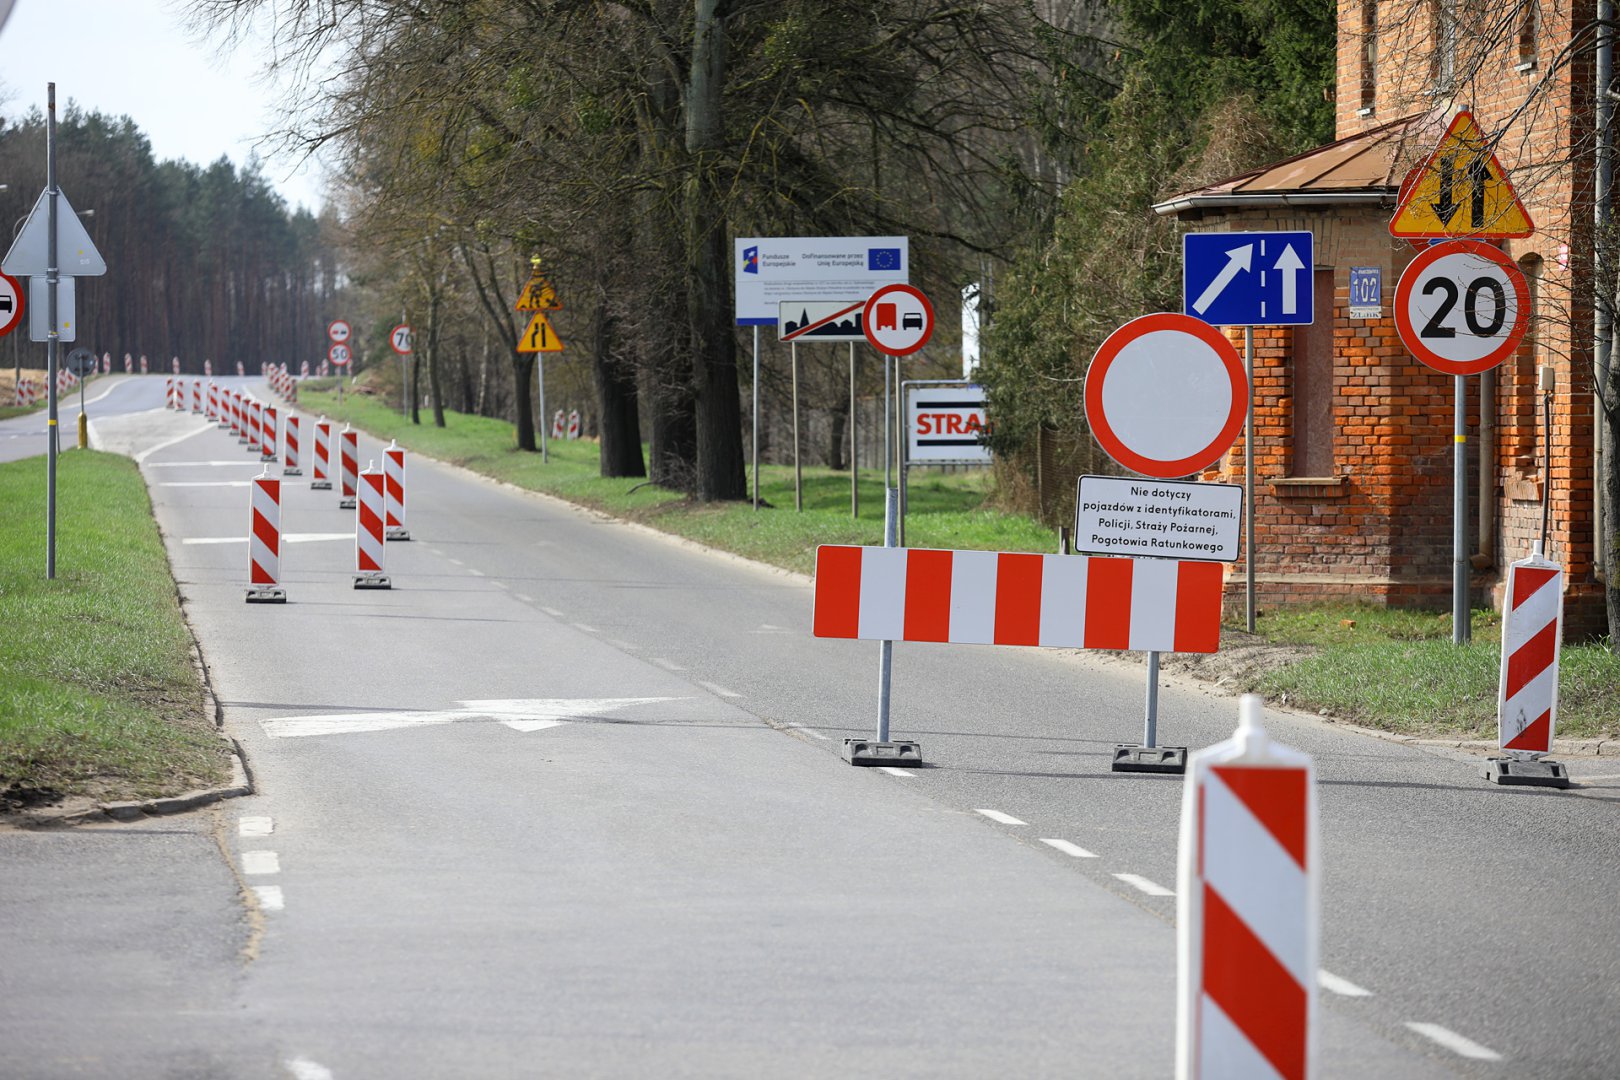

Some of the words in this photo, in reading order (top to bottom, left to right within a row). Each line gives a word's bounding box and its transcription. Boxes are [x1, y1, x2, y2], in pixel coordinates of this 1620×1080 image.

[1353, 278, 1377, 303] 102
[1420, 276, 1506, 339] 20
[332, 348, 348, 359] 50
[1130, 486, 1149, 497] Nie
[1151, 488, 1191, 501] dotyczy
[1083, 501, 1134, 513] pojazdów
[1144, 504, 1237, 520] identyfikatorami,
[1098, 517, 1133, 530] Policji,
[1136, 520, 1168, 534] Straży
[1170, 522, 1219, 537] Pożarnej,
[1091, 534, 1148, 547] Pogotowia
[1151, 538, 1224, 553] Ratunkowego
